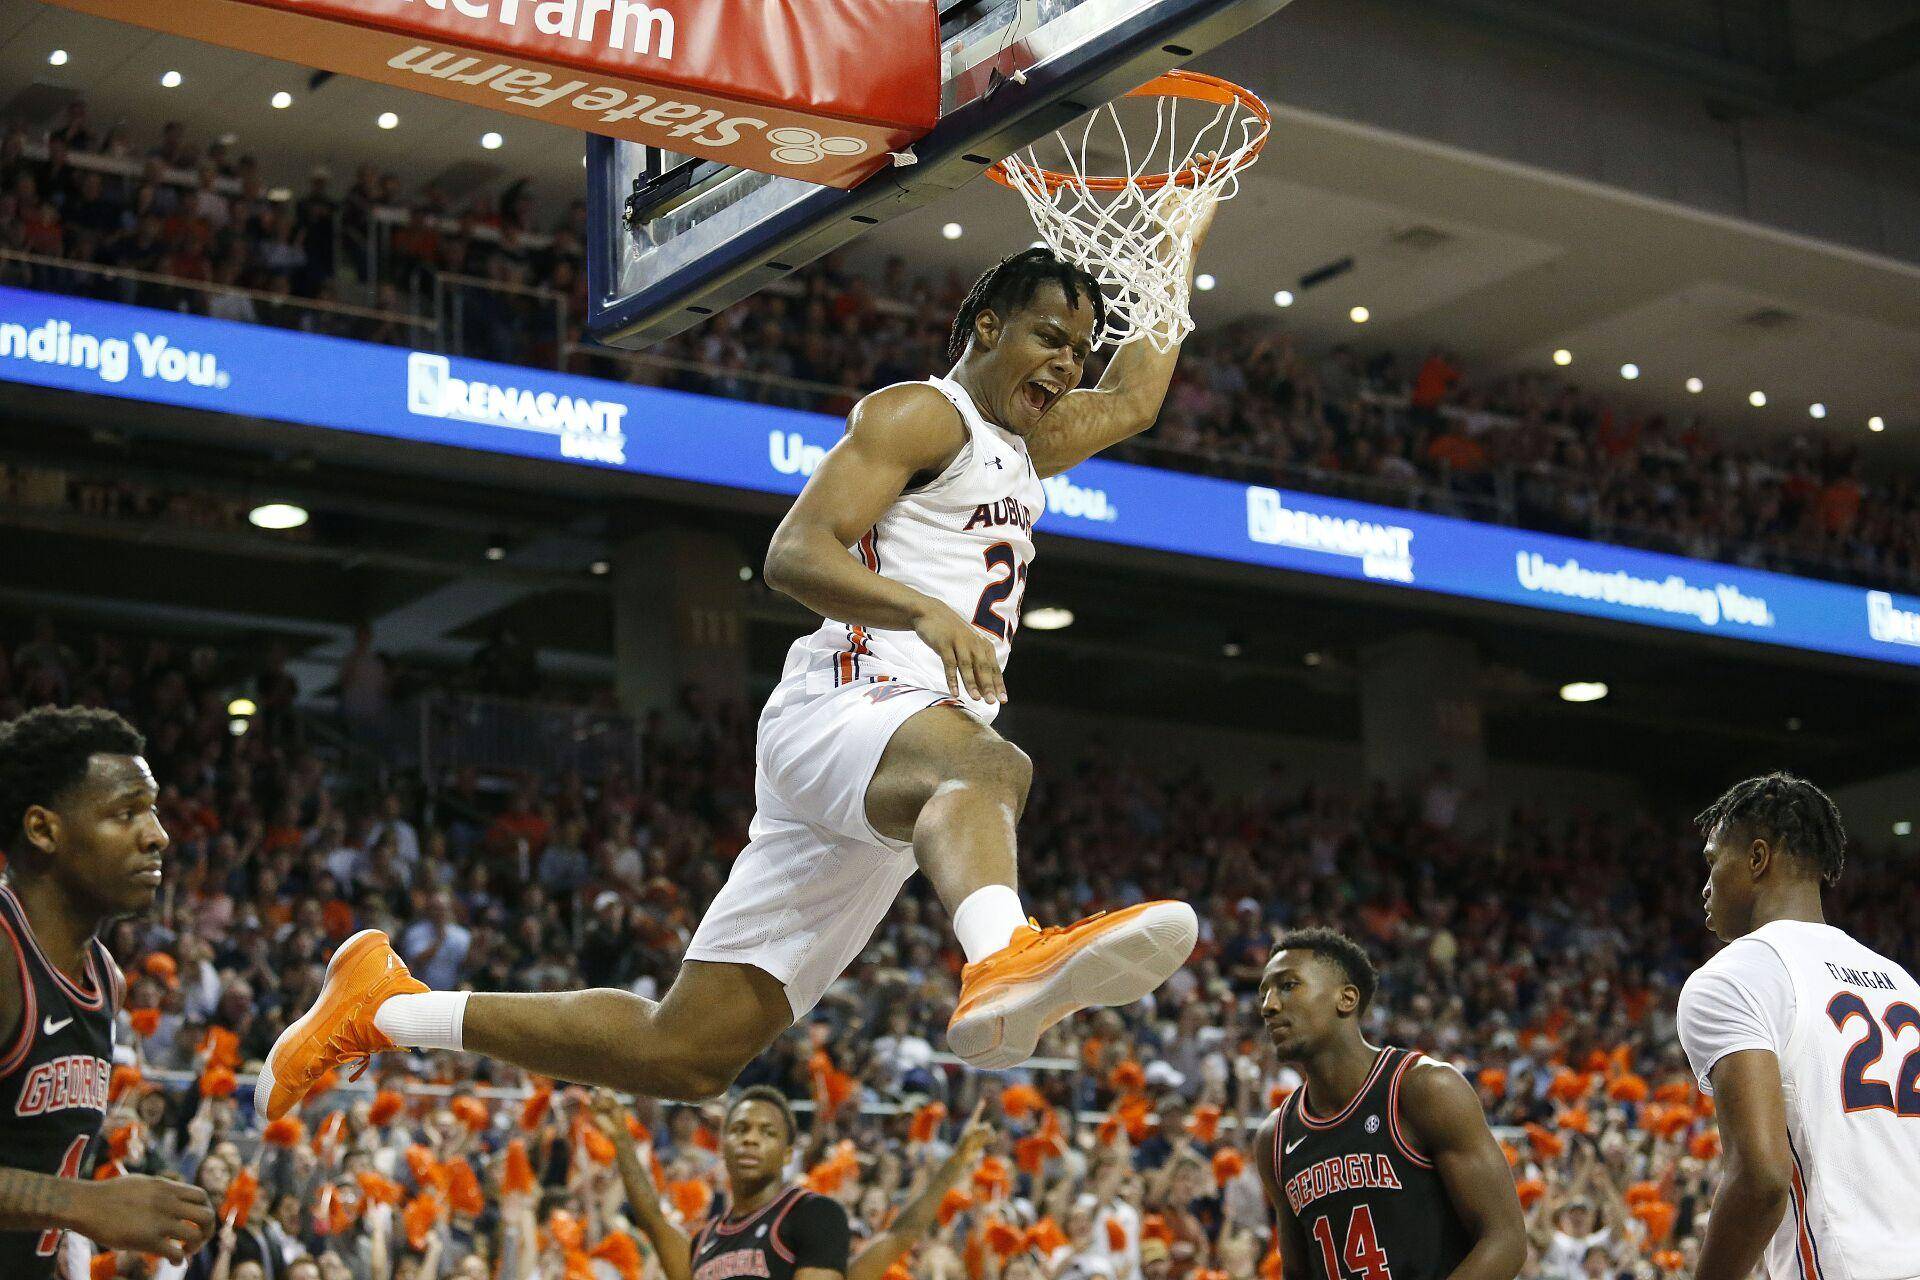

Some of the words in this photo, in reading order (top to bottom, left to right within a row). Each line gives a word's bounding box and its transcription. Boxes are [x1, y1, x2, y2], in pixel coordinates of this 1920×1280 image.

[1824, 961, 1898, 991] FLANIGAN
[1825, 990, 1920, 1118] 22
[1285, 1153, 1403, 1217] GEORGIA
[1312, 1203, 1393, 1280] 14
